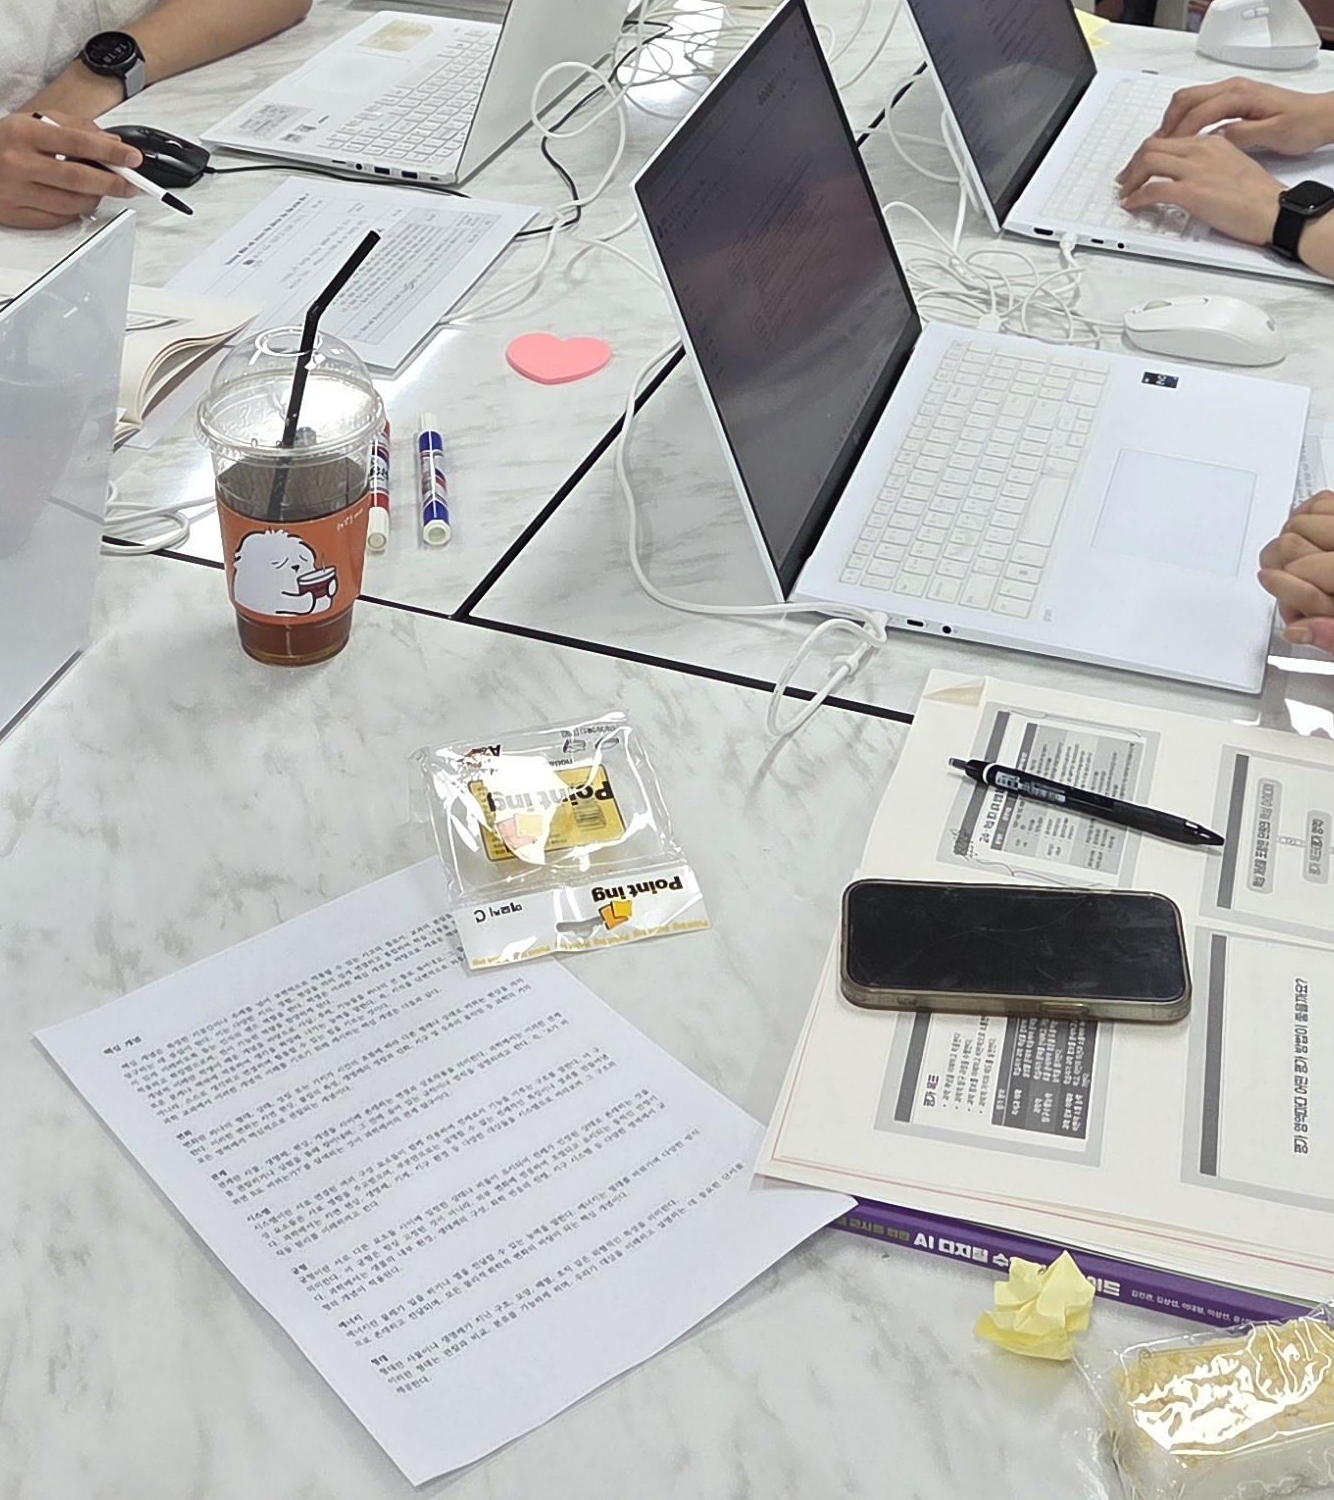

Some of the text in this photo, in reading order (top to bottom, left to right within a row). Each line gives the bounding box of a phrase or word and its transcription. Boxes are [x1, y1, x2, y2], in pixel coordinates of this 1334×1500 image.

[591, 876, 683, 904] Point ing
[1293, 977, 1308, 1154] 평가 영역마다 어떤 평가 방법이 좋을까요?
[914, 1231, 934, 1250] AI
[938, 1237, 988, 1263] 디지털
[1086, 1274, 1121, 1297] 이드
